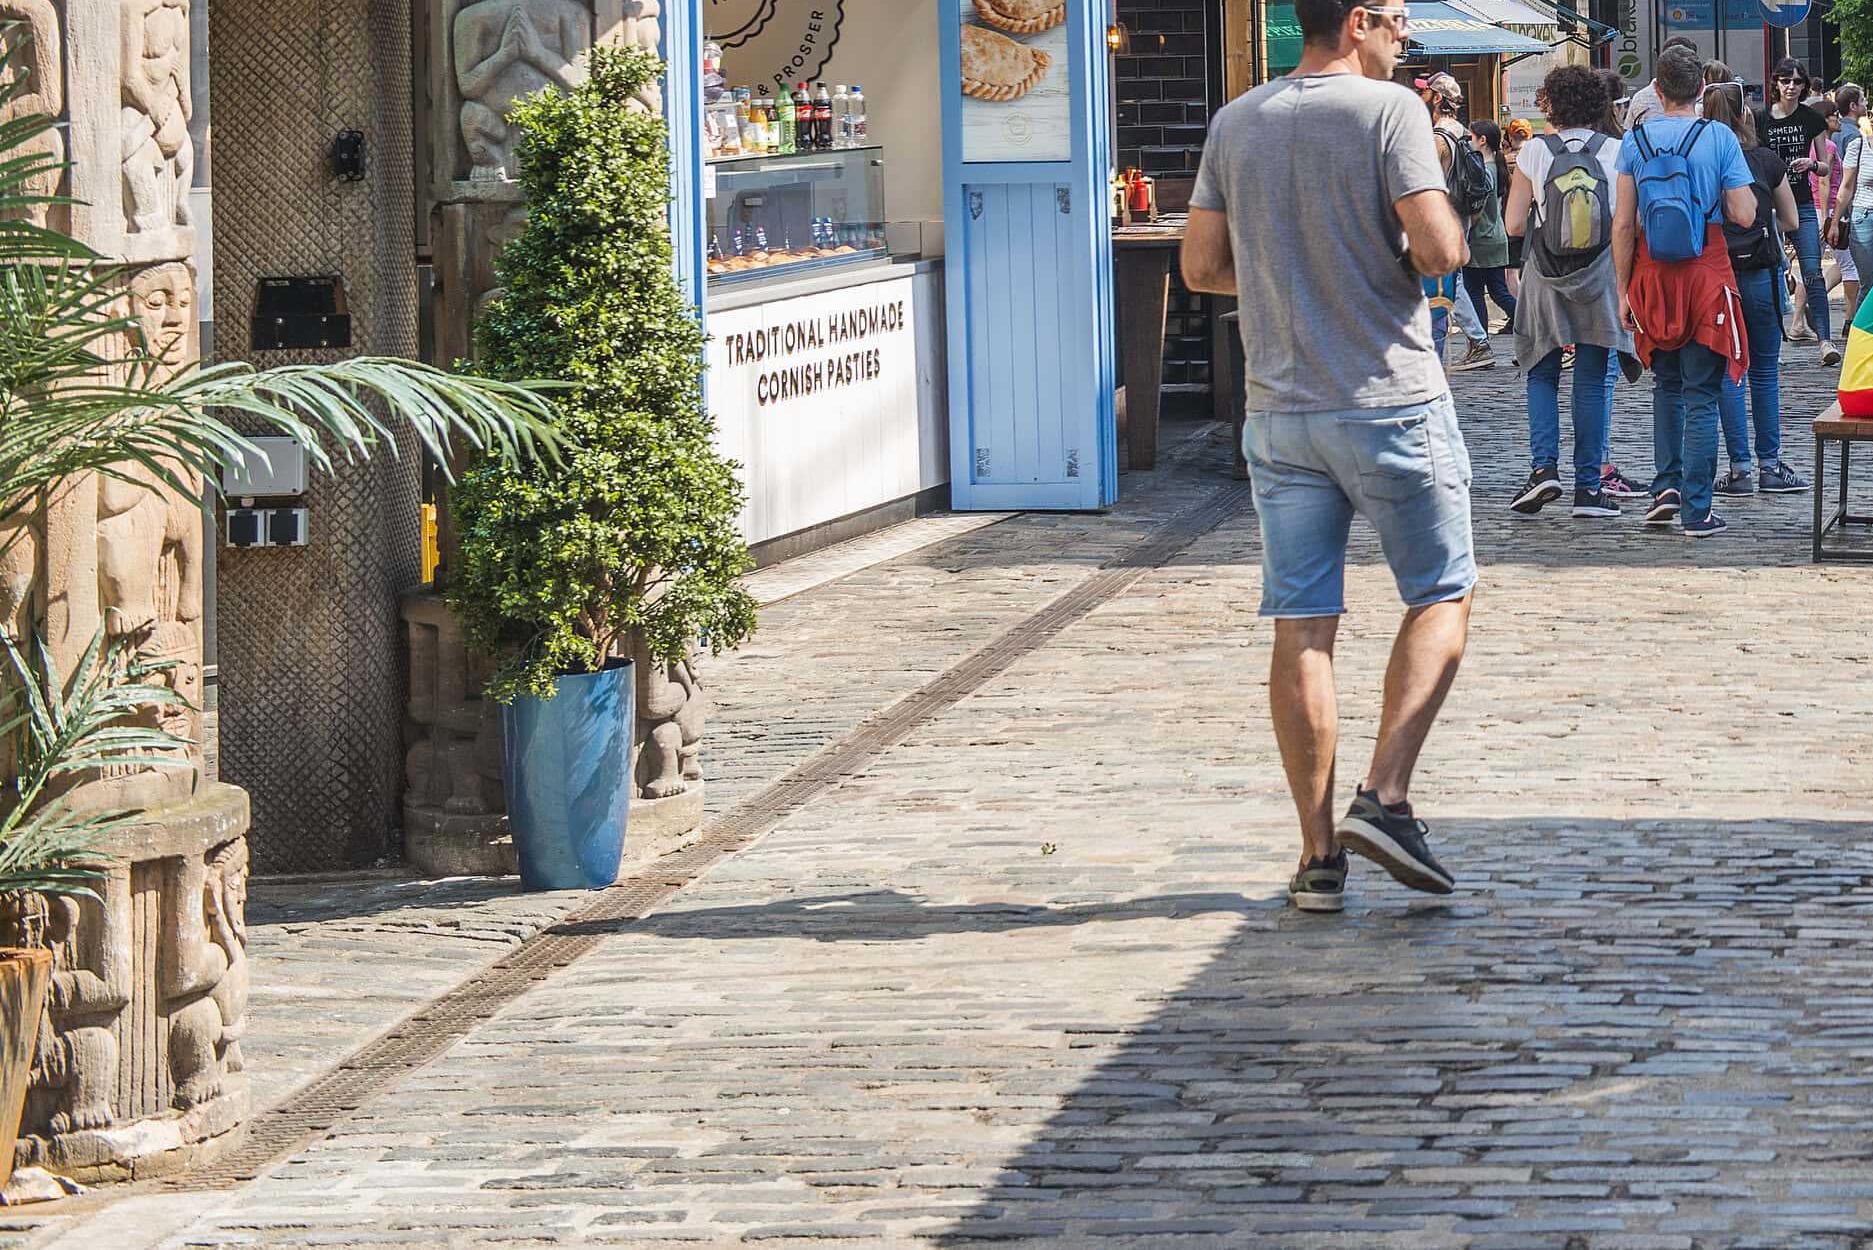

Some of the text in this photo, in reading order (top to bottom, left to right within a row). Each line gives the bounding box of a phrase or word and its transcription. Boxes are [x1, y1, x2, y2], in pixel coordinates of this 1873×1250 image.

[773, 9, 825, 86] PROSPER
[757, 83, 771, 96] &
[725, 300, 904, 368] TRADITIONAL HANDMADE
[757, 348, 881, 407] CORNISH PASTIES
